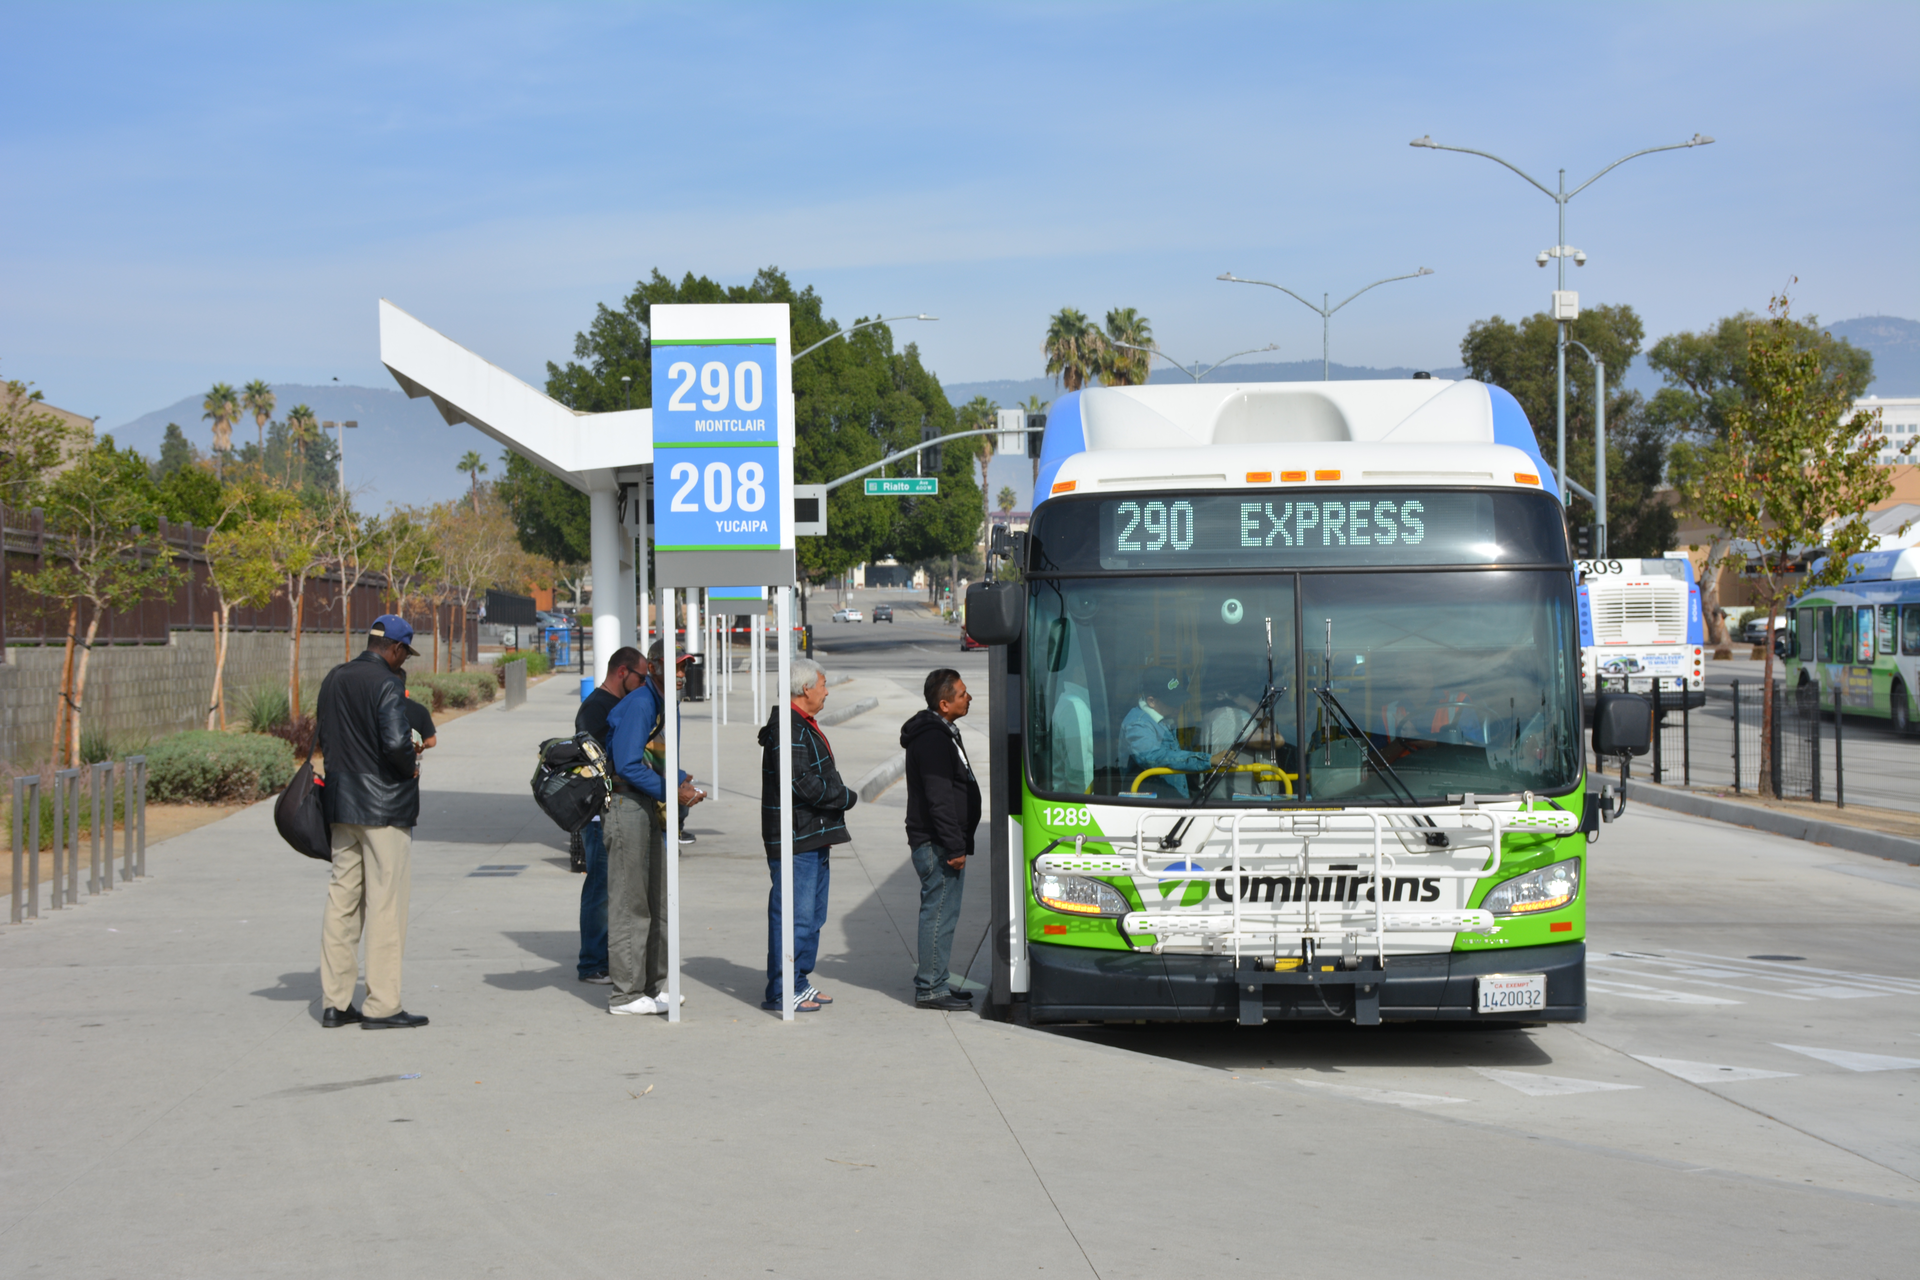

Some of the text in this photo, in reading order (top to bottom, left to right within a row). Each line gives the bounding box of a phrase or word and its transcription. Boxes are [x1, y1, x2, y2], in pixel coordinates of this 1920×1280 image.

[668, 361, 763, 412] 290
[695, 419, 765, 432] MONTCLAIR
[670, 462, 766, 513] 208
[883, 482, 910, 491] Rialto
[716, 520, 768, 533] YUCAIPA
[1117, 500, 1425, 551] 290 EXPRESS
[1043, 807, 1091, 826] 1289
[1215, 864, 1441, 903] OmniTrans
[1482, 989, 1541, 1008] 1420032
